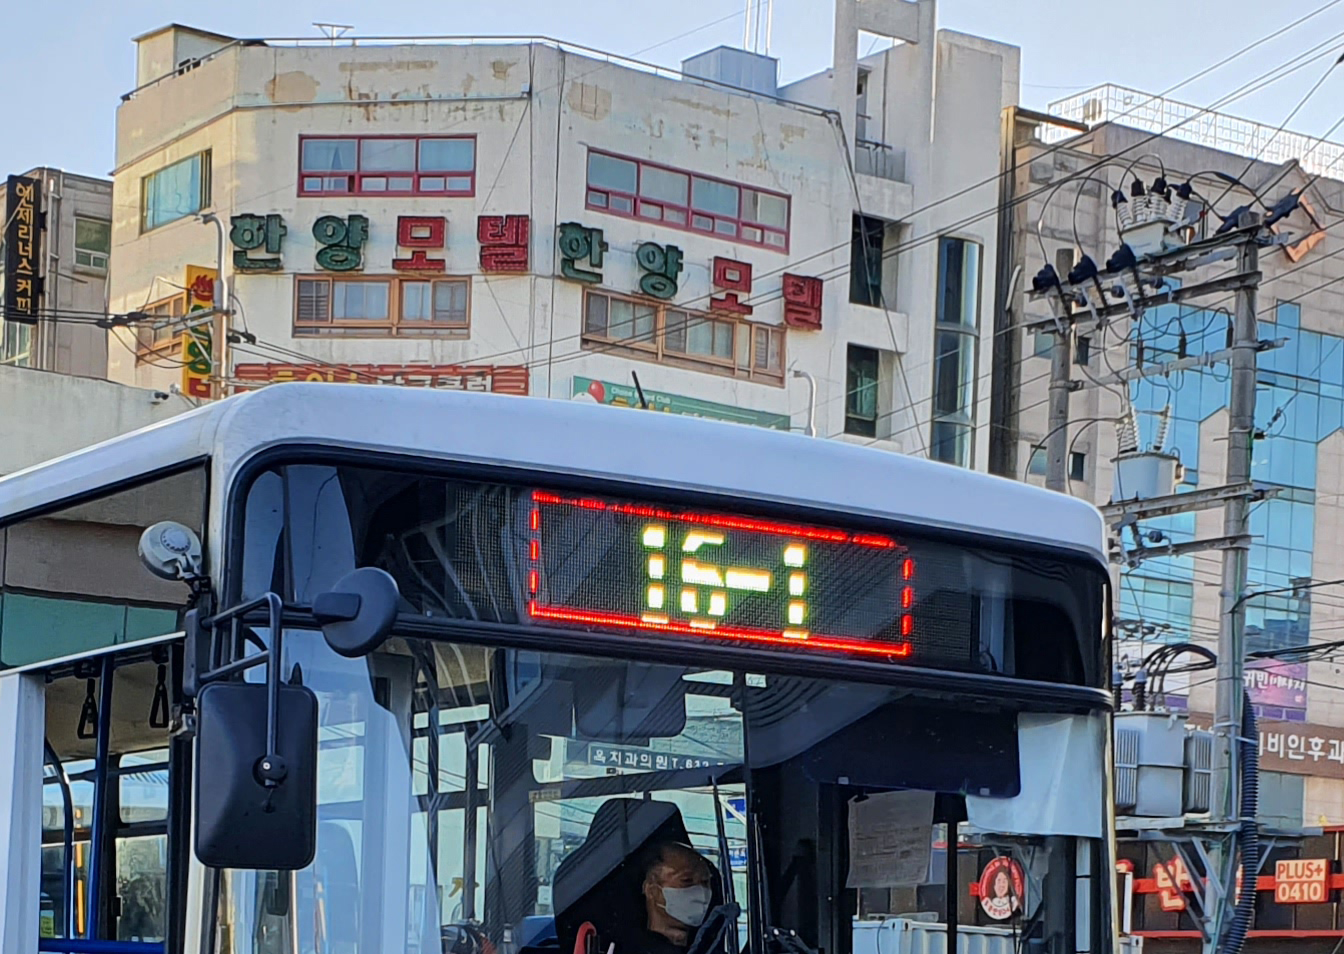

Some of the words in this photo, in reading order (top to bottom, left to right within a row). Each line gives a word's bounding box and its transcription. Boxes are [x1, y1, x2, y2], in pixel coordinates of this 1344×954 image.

[230, 213, 530, 272] 한양모텔
[558, 221, 823, 331] 한양모텔
[642, 523, 810, 639] 16-1
[594, 750, 668, 769] 옥치과의원
[1277, 861, 1324, 880] PLUS+
[1279, 882, 1322, 900] 0410
